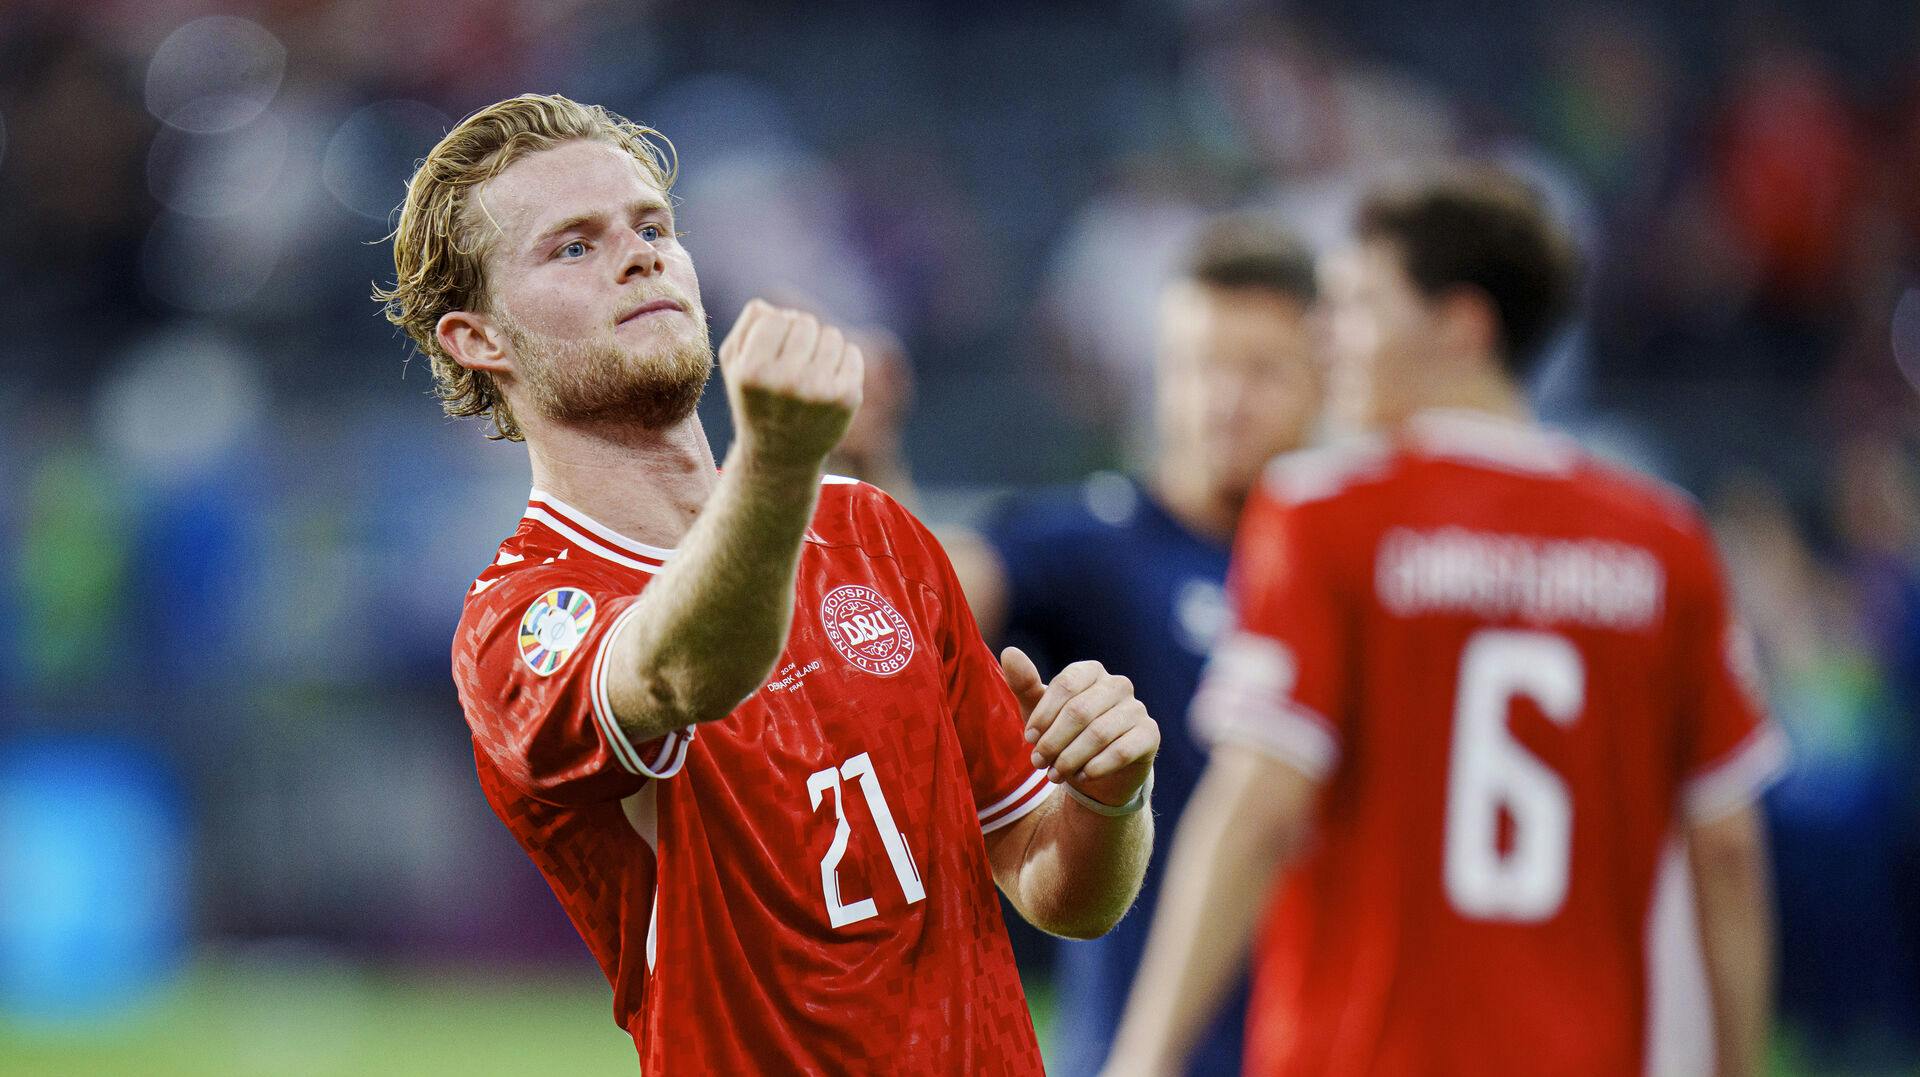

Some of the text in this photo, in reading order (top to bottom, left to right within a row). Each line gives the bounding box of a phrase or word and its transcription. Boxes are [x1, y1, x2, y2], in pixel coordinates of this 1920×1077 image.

[825, 621, 868, 668] DANSK
[873, 653, 905, 672] 1889
[839, 610, 894, 646] DBU
[1443, 630, 1586, 923] 6
[806, 751, 927, 929] 21
